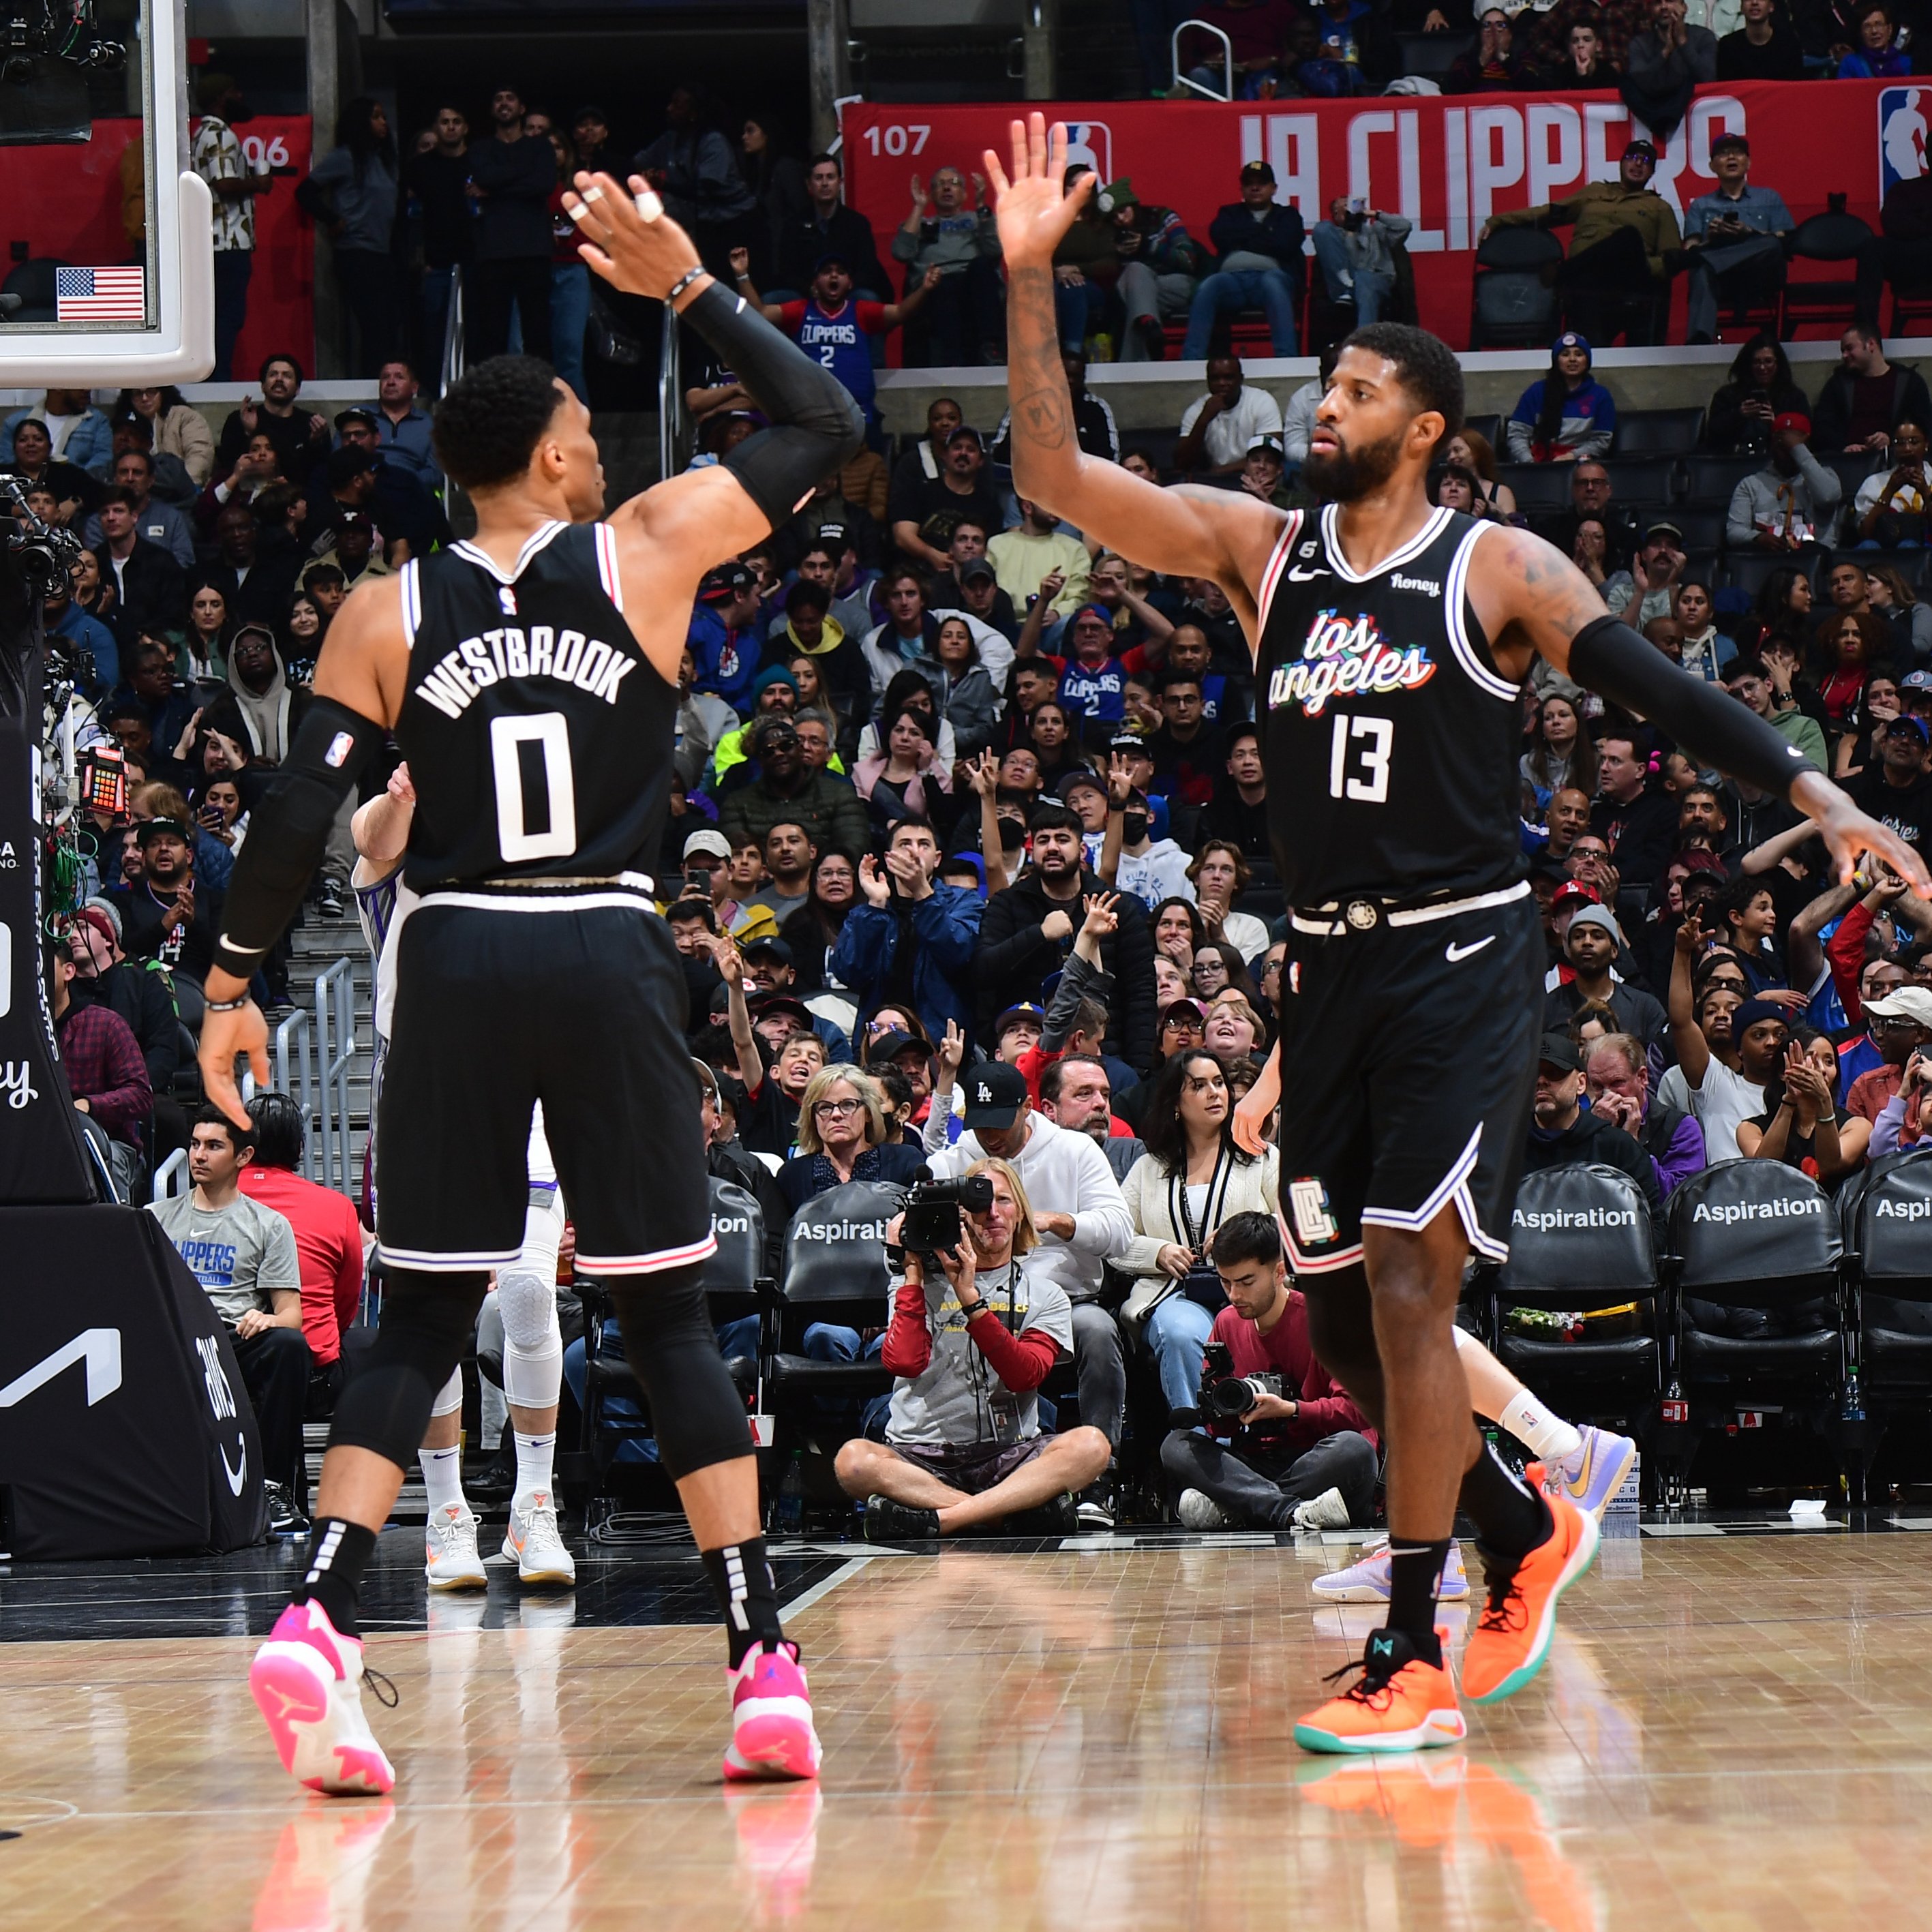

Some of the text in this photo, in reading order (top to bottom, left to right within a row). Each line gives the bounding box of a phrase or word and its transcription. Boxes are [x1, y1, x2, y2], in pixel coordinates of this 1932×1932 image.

[242, 136, 290, 167] 06
[862, 125, 931, 156] 107
[801, 324, 856, 344] CLIPPERS
[820, 346, 834, 368] 2
[1299, 541, 1318, 559] 6
[1391, 573, 1440, 597] honey
[1303, 613, 1378, 661] los
[414, 625, 637, 720] WESTBROOK
[1268, 642, 1432, 715] angeles
[1085, 693, 1100, 716] 2
[1329, 714, 1393, 803] 13
[489, 711, 577, 863] 0
[977, 1081, 993, 1102] LA
[1511, 1207, 1636, 1233] Aspiration
[1693, 1197, 1822, 1225] Aspiration
